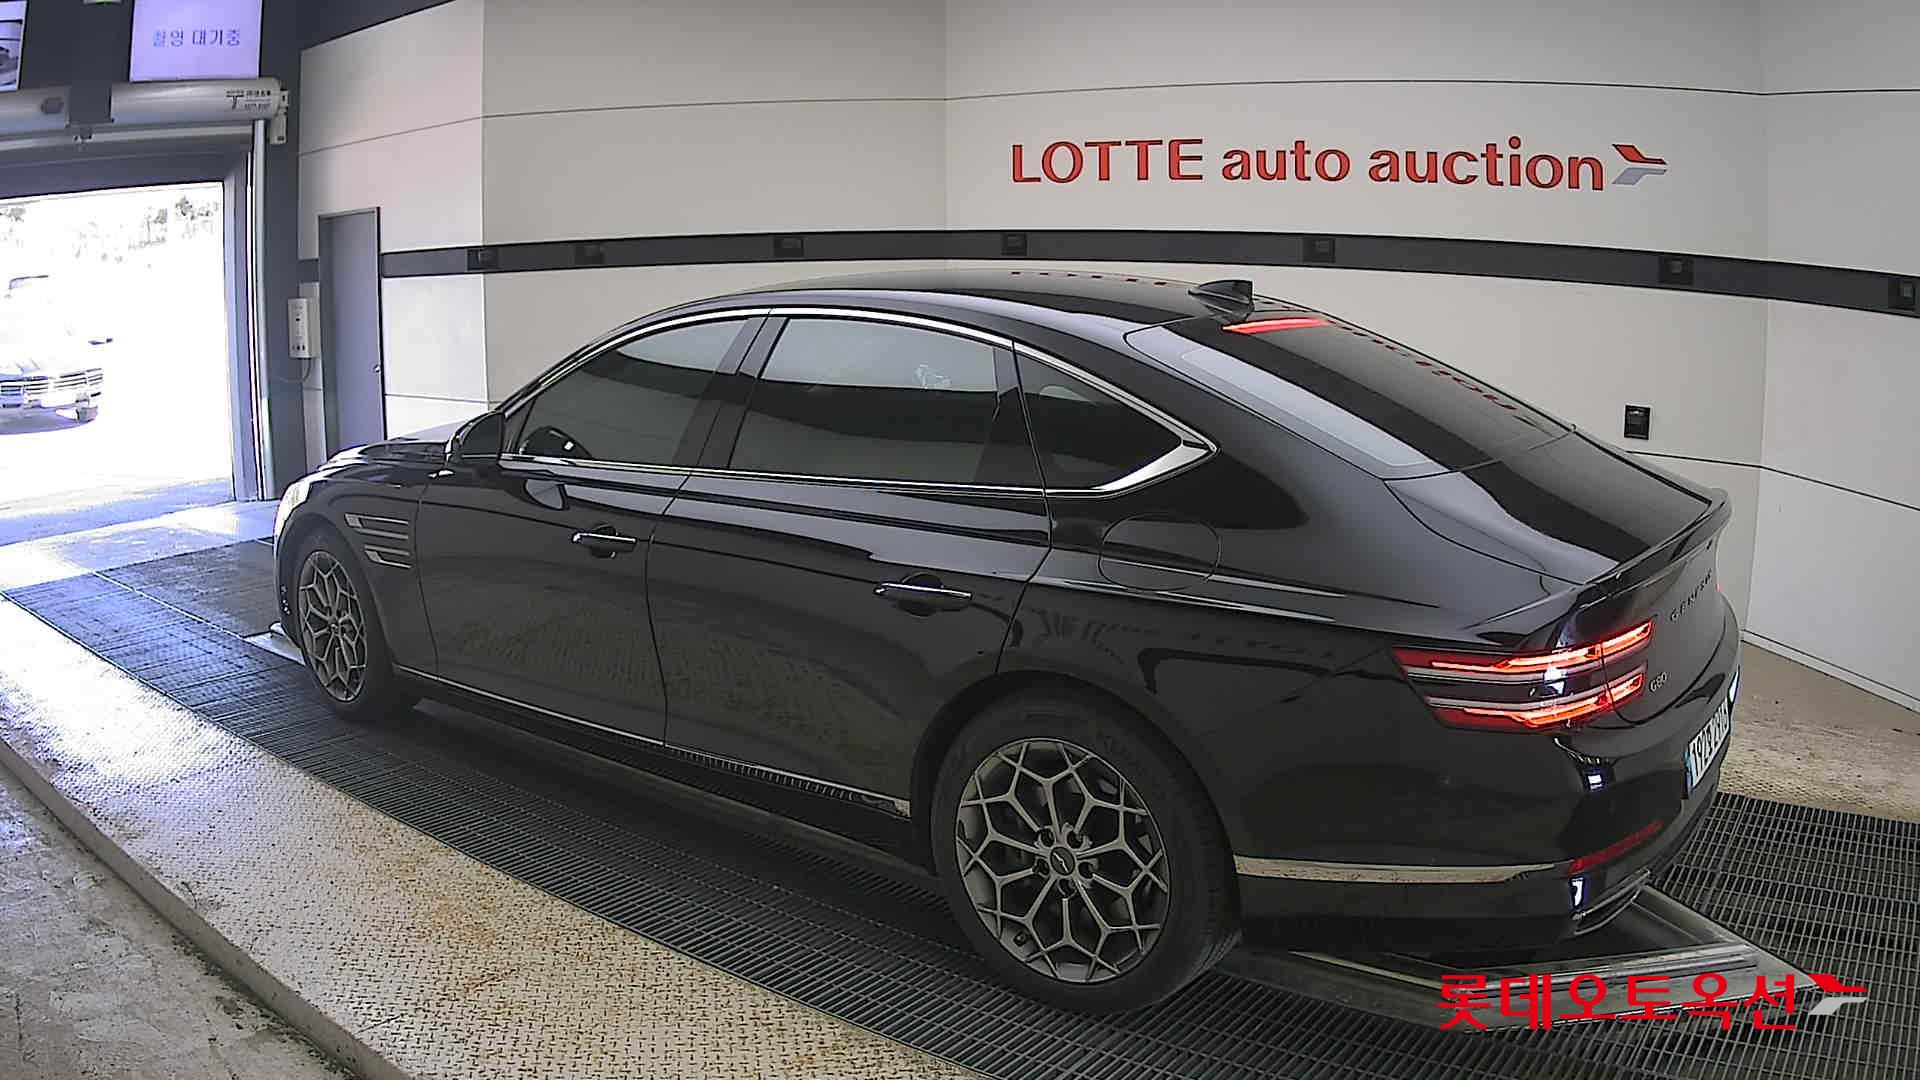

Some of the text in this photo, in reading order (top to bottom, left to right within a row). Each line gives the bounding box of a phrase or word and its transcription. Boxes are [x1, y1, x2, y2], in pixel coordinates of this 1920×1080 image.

[1011, 136, 1605, 192] LOTTE auto auction
[1649, 671, 1667, 692] G80
